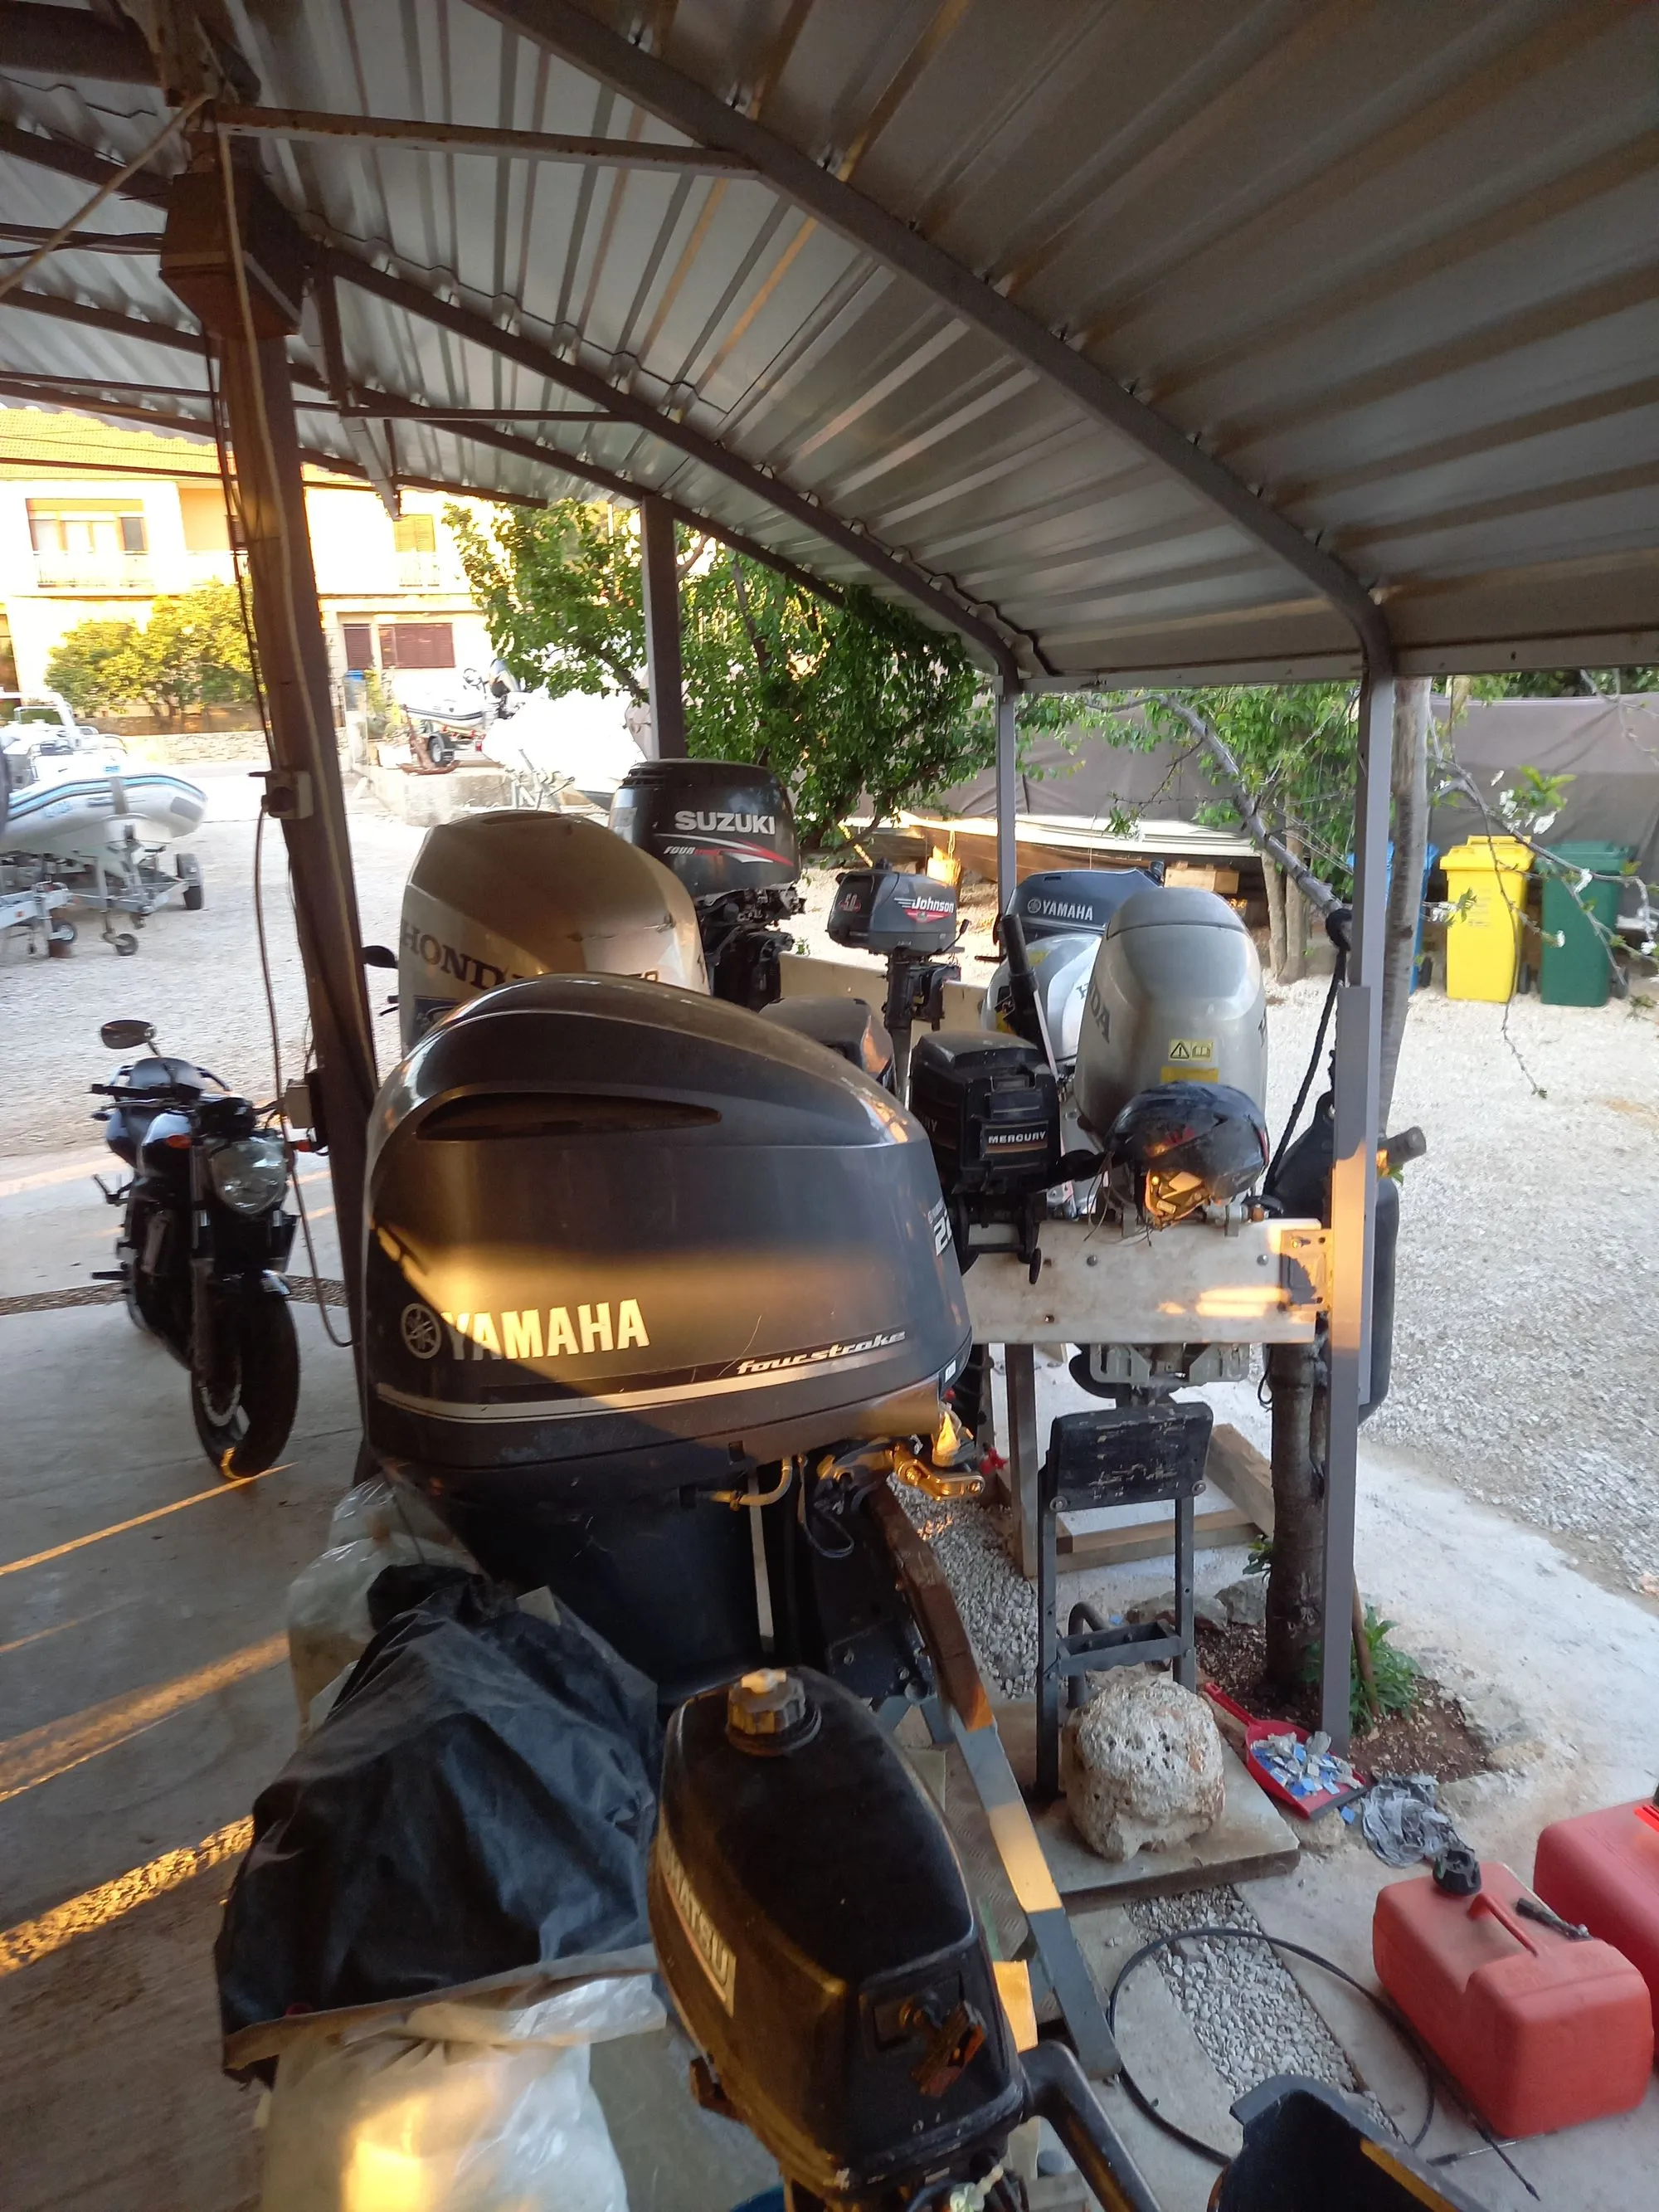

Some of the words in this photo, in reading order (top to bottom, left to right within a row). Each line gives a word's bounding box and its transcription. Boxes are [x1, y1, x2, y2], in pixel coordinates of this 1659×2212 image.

[674, 811, 776, 835] SUZUKI
[664, 846, 696, 855] FOUR
[912, 896, 954, 913] Johnson
[1043, 899, 1093, 921] YAMAHA
[402, 918, 524, 990] HOND
[988, 1131, 1047, 1144] MERCURY
[440, 1298, 650, 1361] YAMAHA
